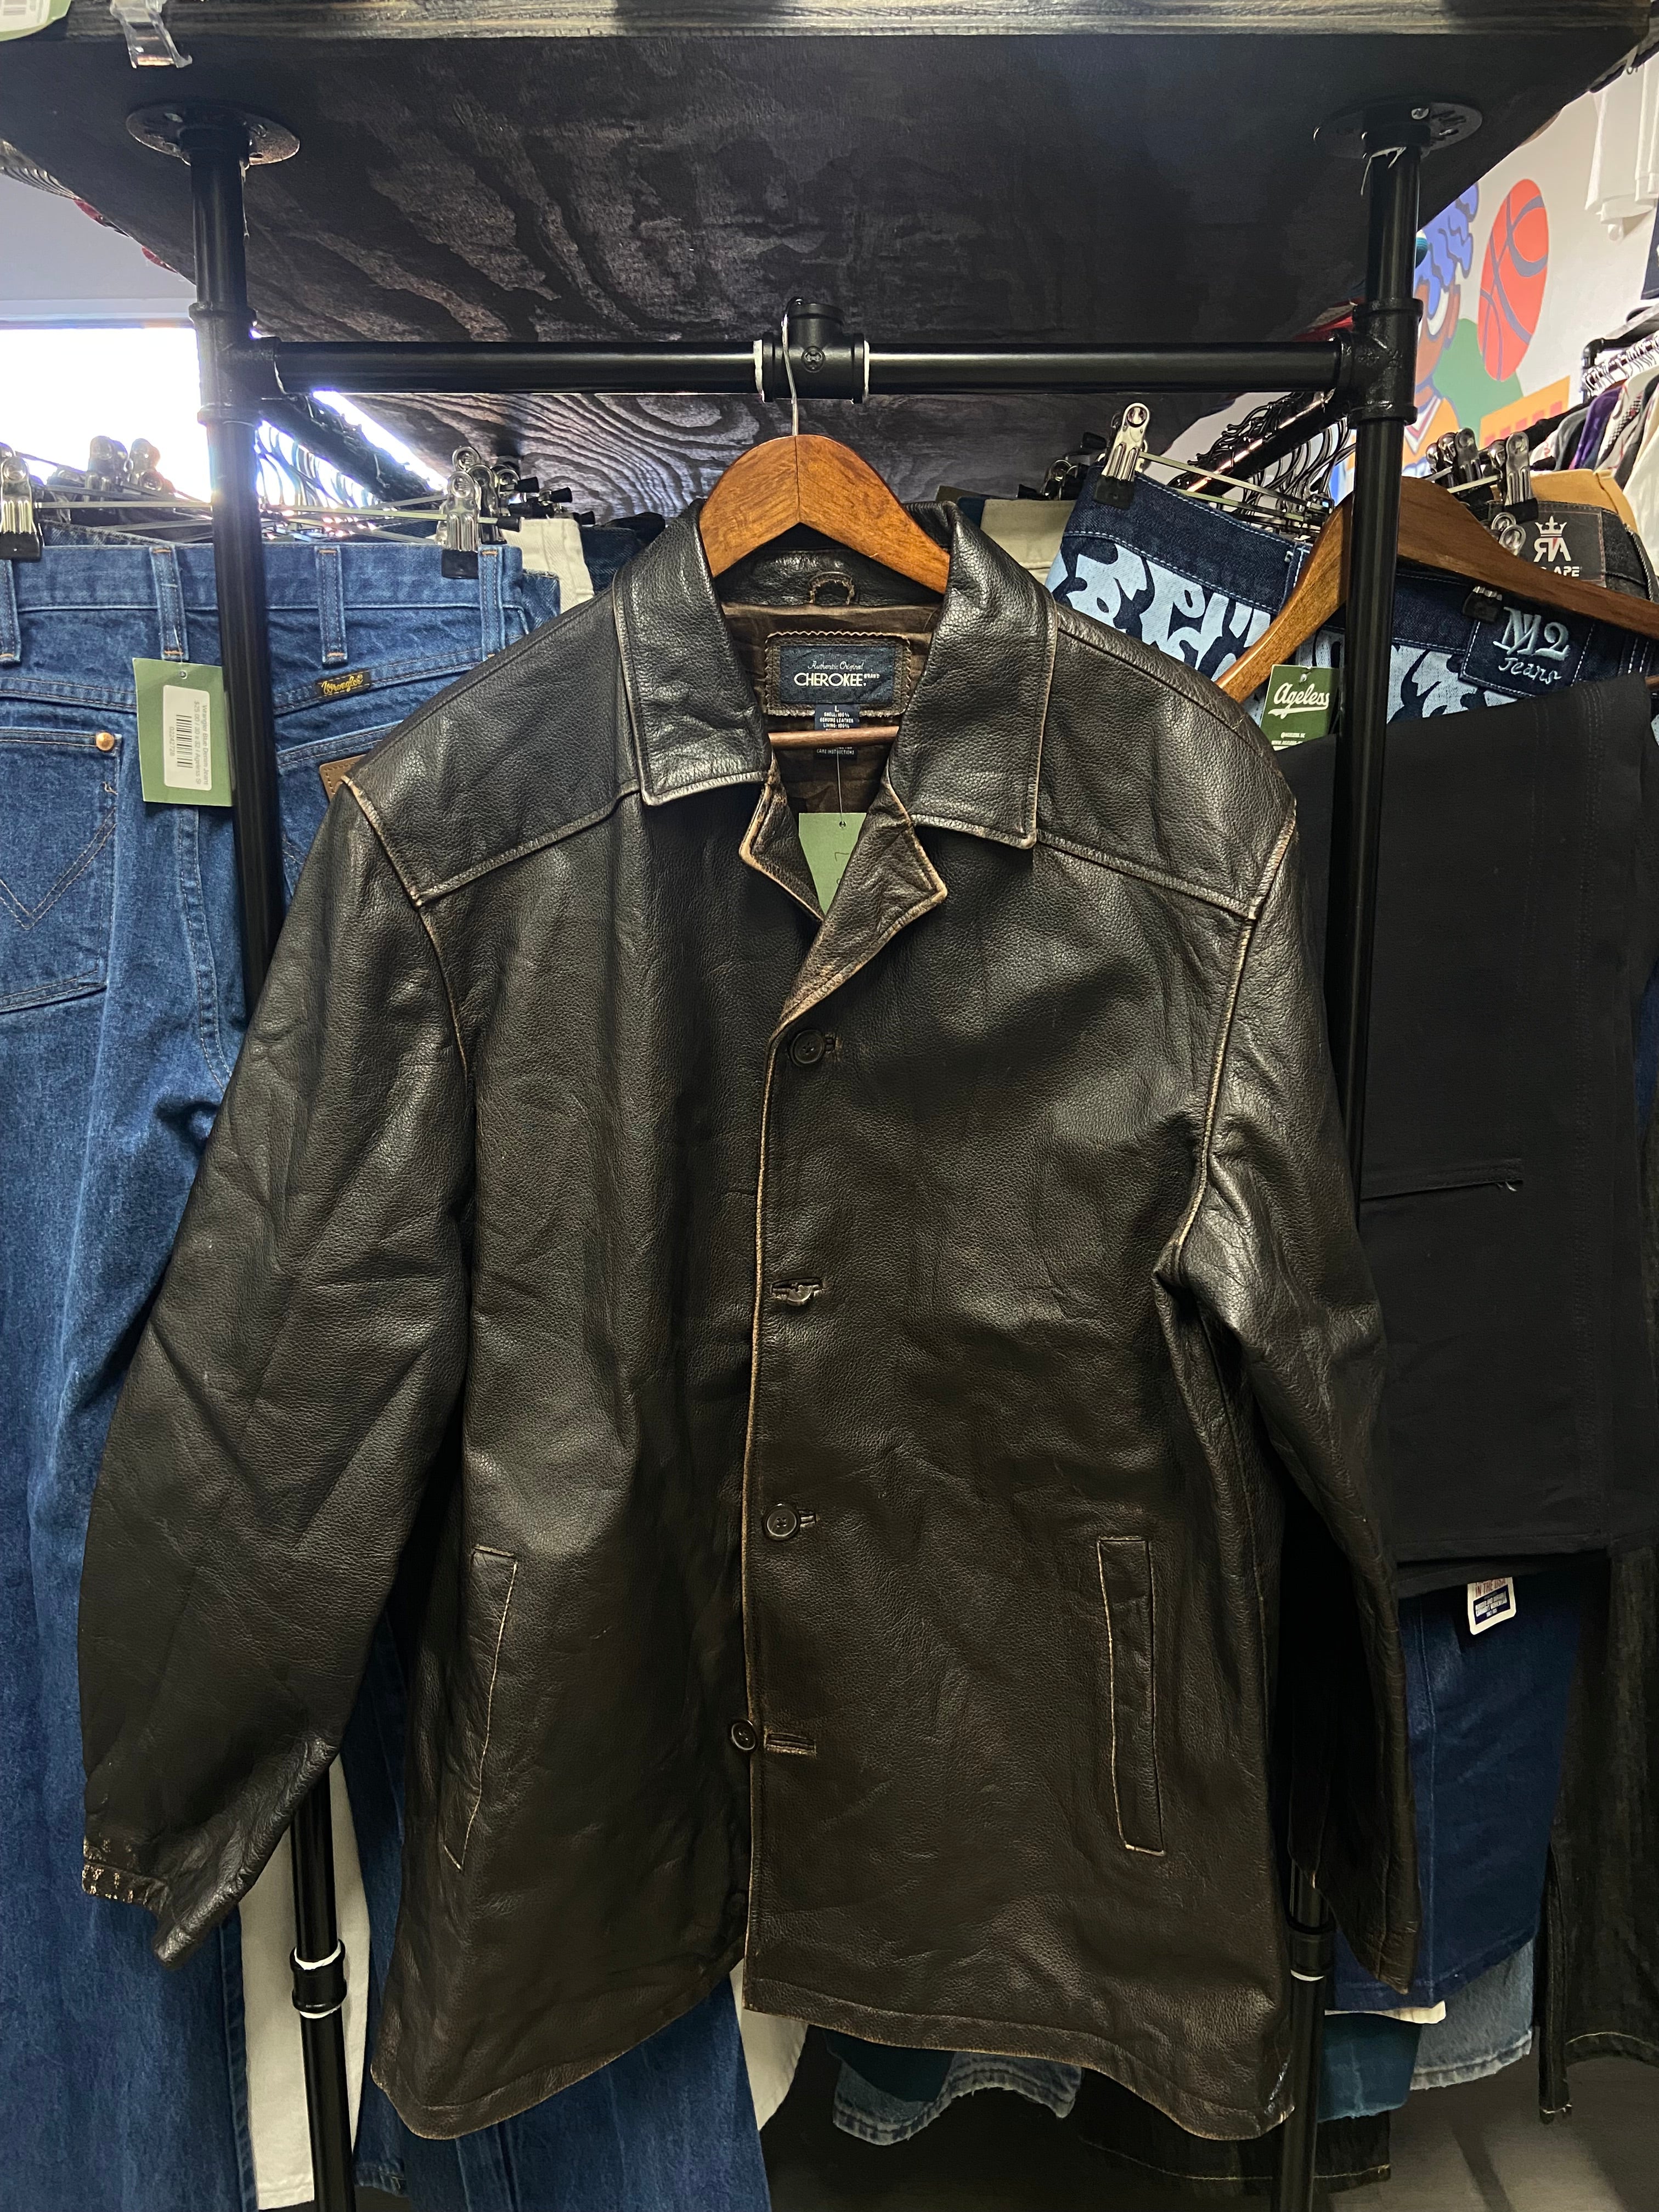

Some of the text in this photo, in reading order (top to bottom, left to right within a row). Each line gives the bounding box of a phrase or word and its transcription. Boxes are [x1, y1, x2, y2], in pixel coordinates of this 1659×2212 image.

[808, 660, 865, 671] Authentic Original
[1498, 658, 1562, 685] Jeans
[321, 674, 363, 695] Wrangler
[1272, 682, 1330, 719] Ageless
